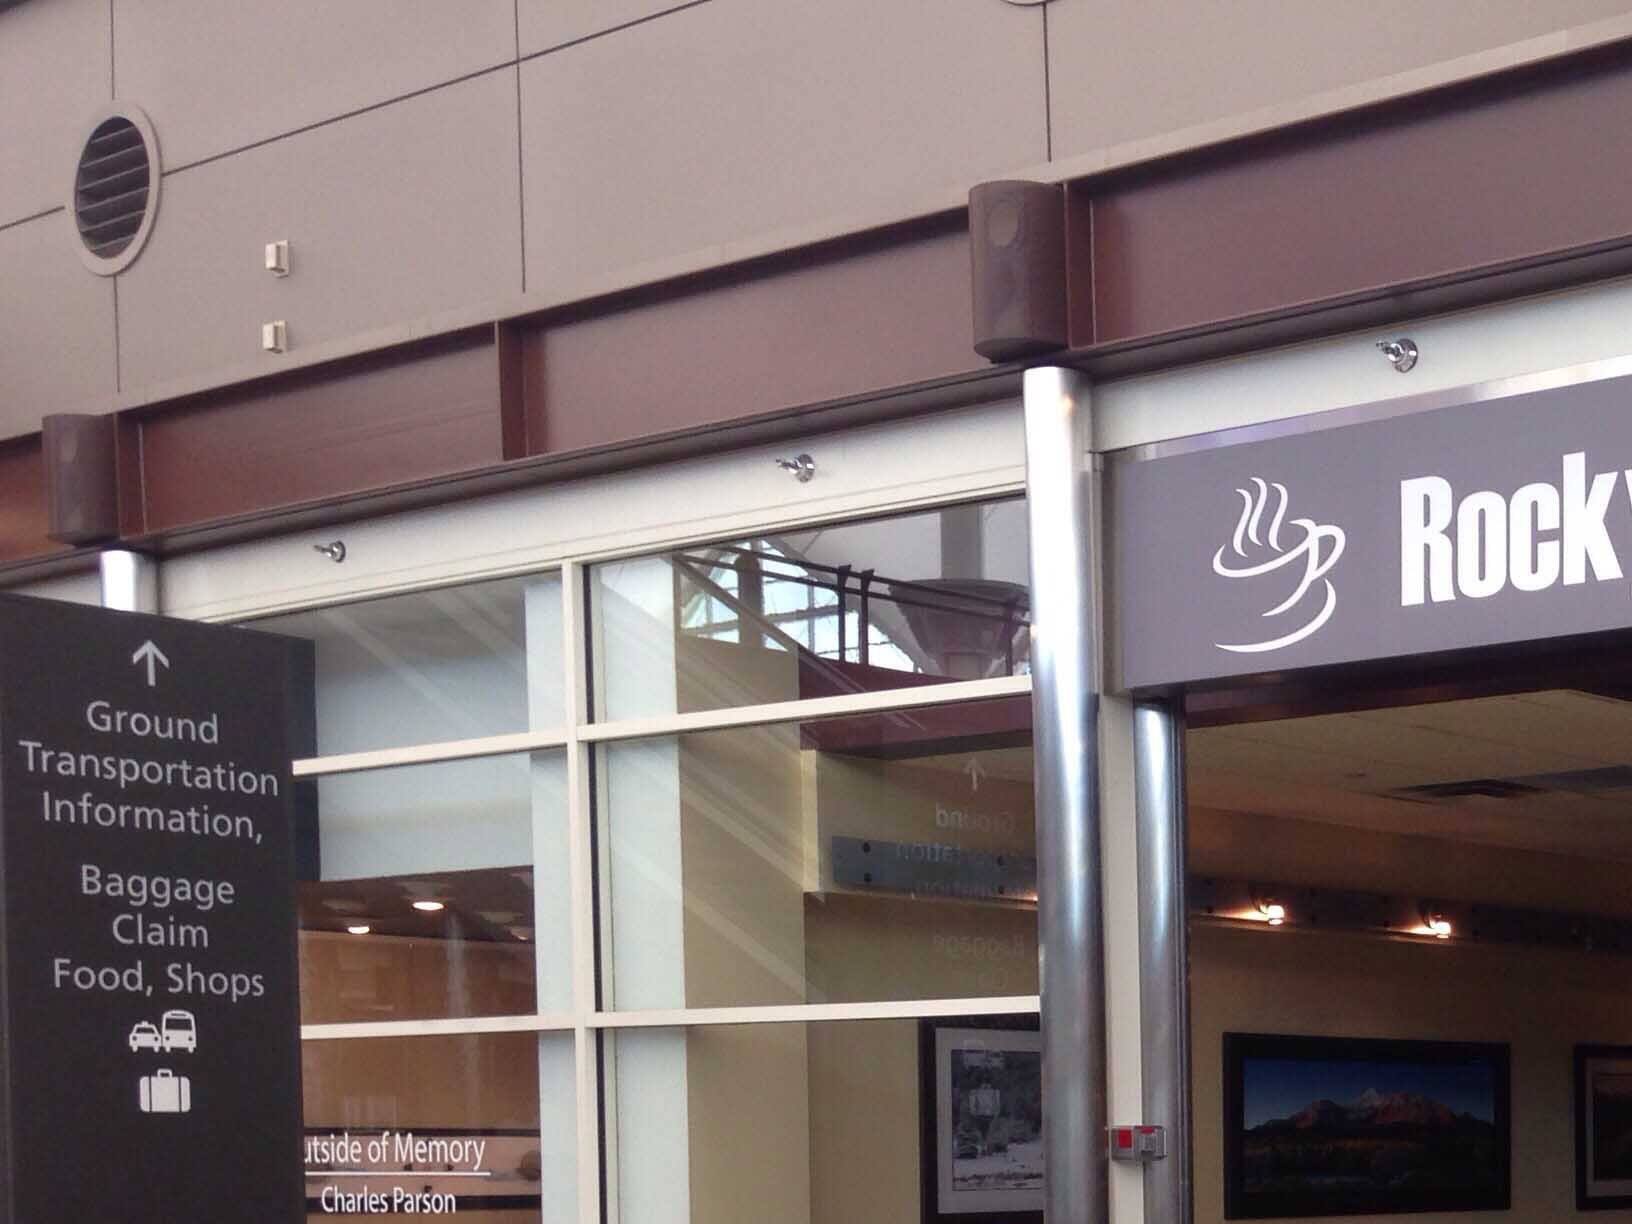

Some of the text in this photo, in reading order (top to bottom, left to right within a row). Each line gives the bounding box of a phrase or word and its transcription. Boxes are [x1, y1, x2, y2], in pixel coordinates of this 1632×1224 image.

[86, 700, 219, 745] Ground
[18, 739, 278, 797] Transportation
[42, 791, 262, 844] Information,
[81, 864, 235, 911] Baggage
[112, 913, 209, 948] Claim
[54, 958, 265, 1003] Food, Shops
[367, 1130, 390, 1163] of
[394, 1132, 486, 1172] Memory
[321, 1185, 456, 1214] Charles Parson
